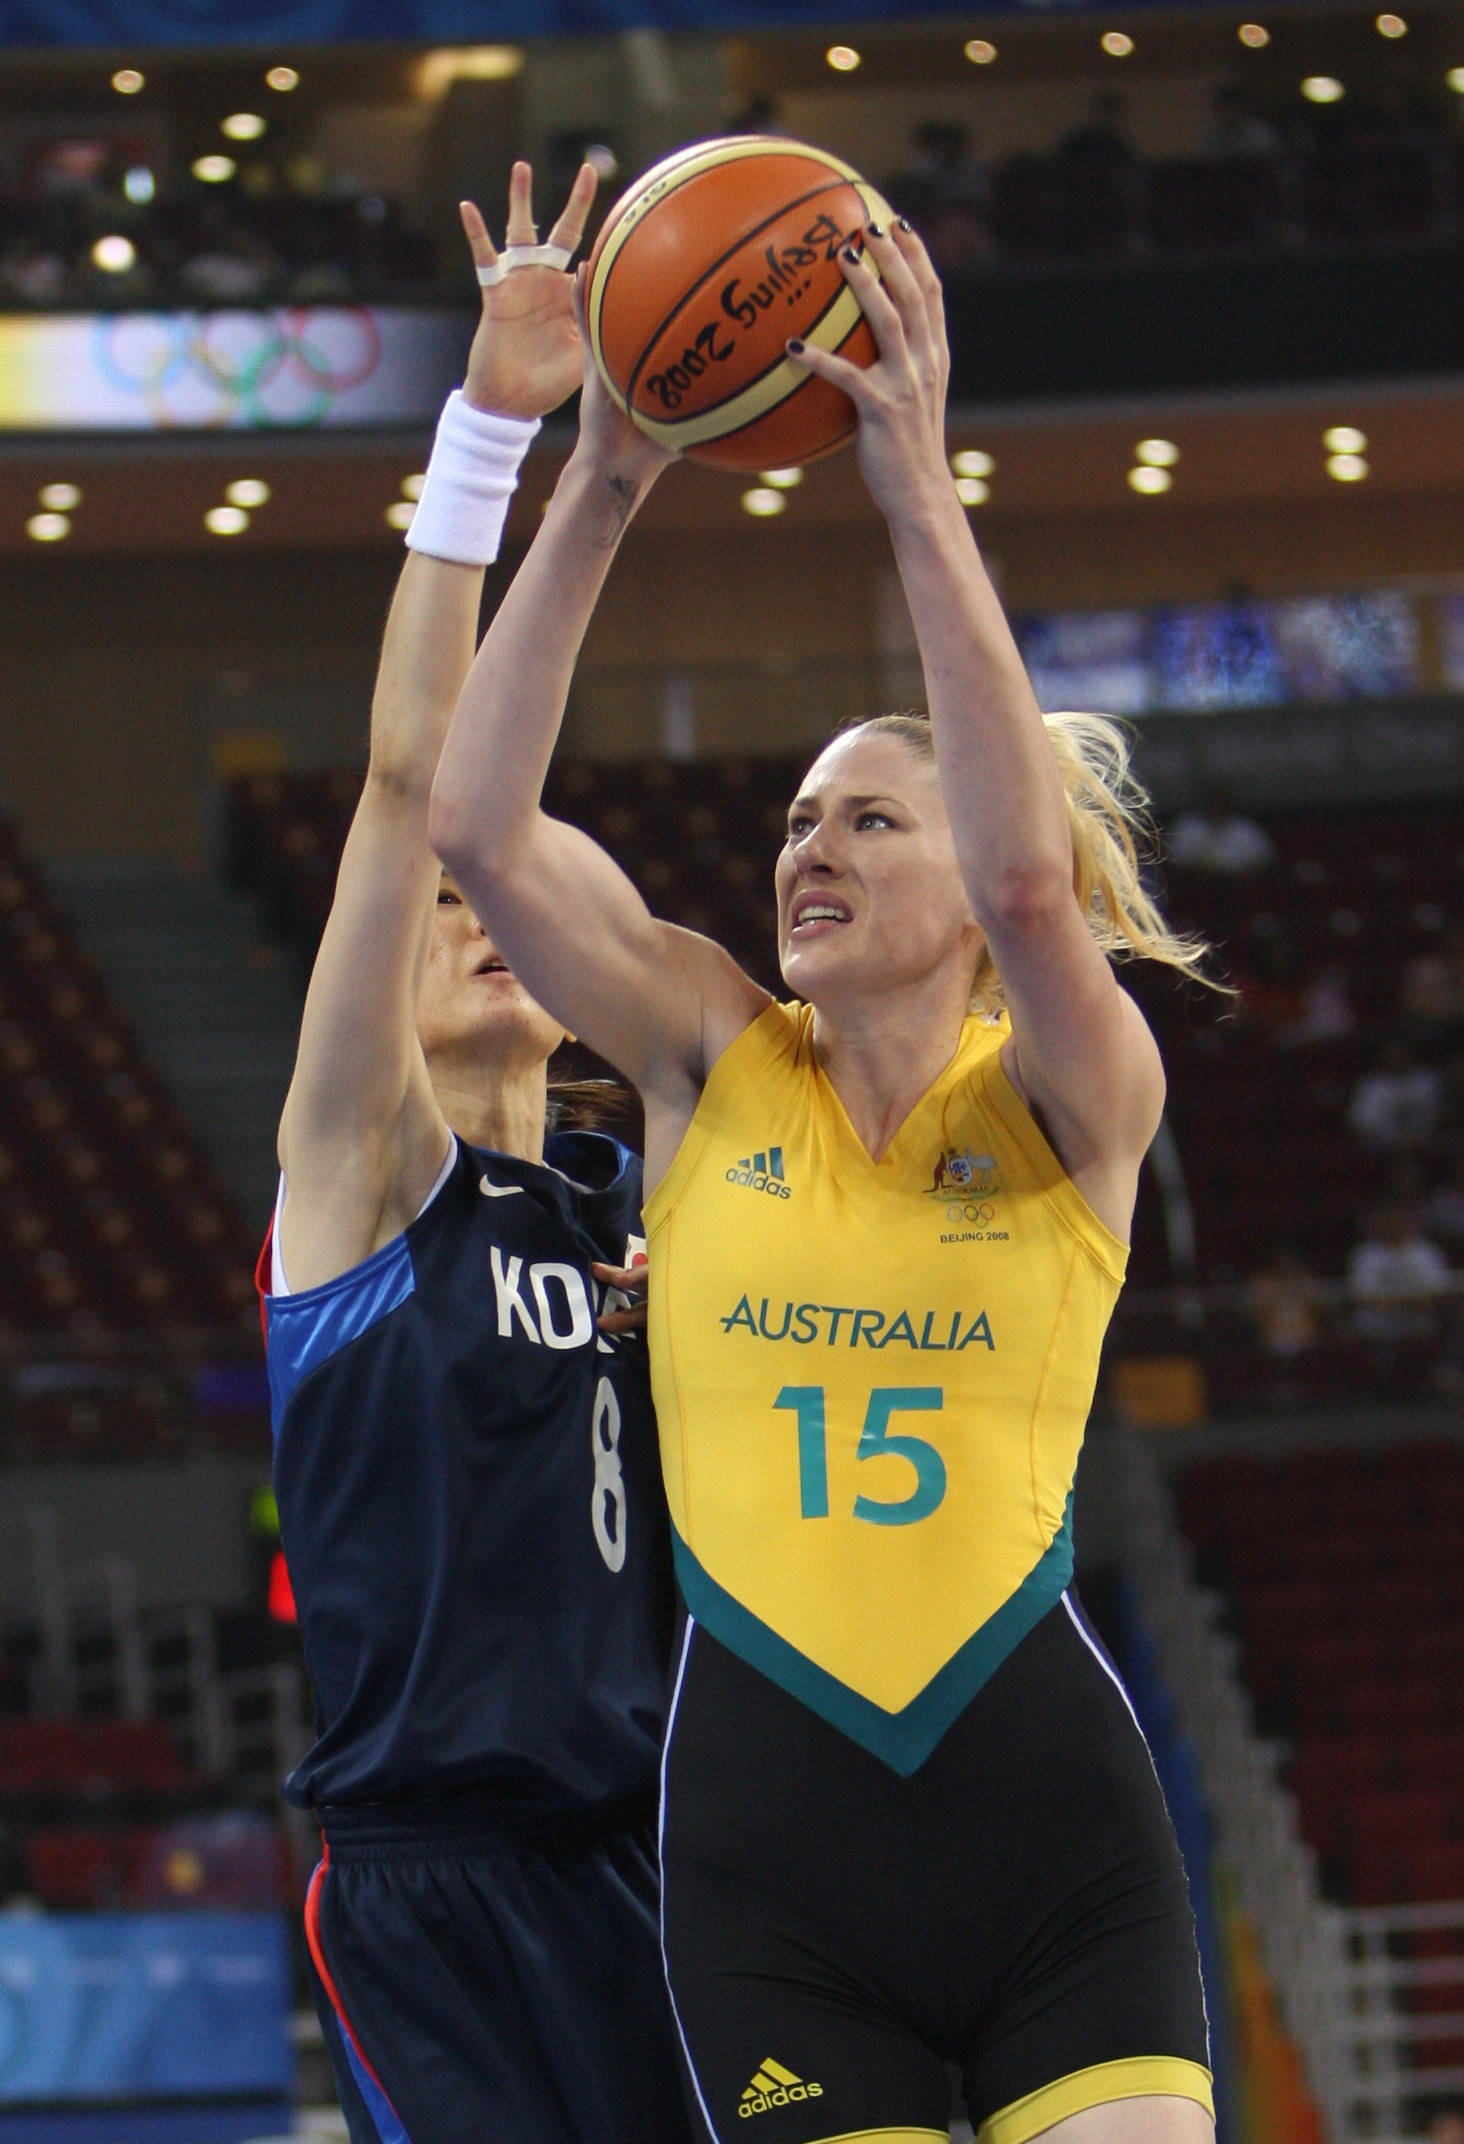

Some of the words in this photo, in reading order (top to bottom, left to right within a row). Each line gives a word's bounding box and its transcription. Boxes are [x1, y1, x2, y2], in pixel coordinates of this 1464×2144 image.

[720, 214, 861, 329] Beijing
[646, 322, 735, 410] 2008
[725, 1168, 792, 1199] adidas
[940, 1232, 984, 1244] BEIJING
[986, 1231, 1010, 1242] 2008
[720, 1294, 995, 1351] AUSTRALIA
[592, 1375, 627, 1574] 8
[772, 1385, 948, 1527] 15
[738, 2082, 824, 2118] adidas
